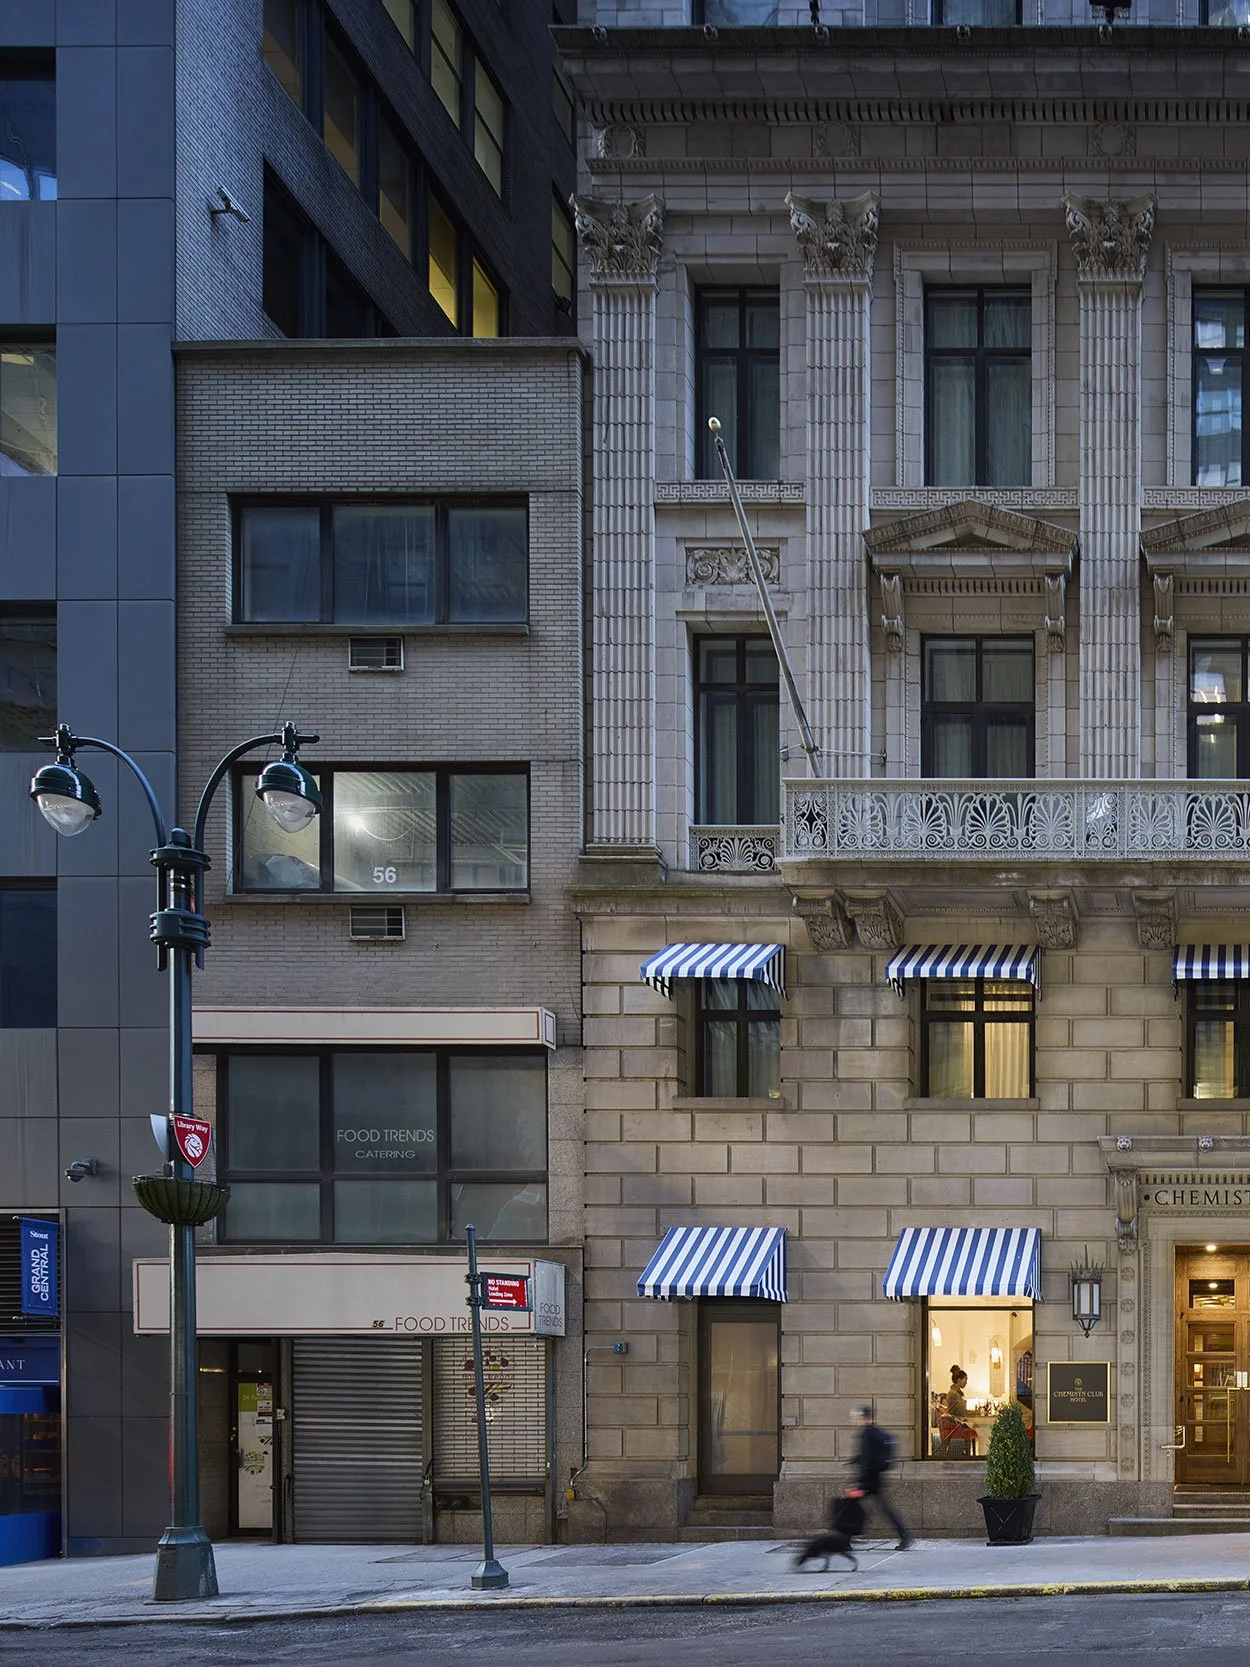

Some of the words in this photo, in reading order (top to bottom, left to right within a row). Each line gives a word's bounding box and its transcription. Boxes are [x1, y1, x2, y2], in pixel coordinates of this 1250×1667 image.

[372, 866, 397, 884] 56
[176, 1120, 195, 1132] Library
[195, 1123, 209, 1134] Way
[336, 1129, 380, 1142] FOOD
[383, 1129, 435, 1142] TRENDS
[355, 1150, 416, 1159] CATERING
[30, 1249, 40, 1294] GRAND
[39, 1243, 49, 1302] CENTRAL
[495, 1279, 520, 1288] STANDING
[540, 1303, 560, 1315] FOOD
[372, 1320, 385, 1328] 56
[395, 1316, 446, 1331] FOOD
[449, 1316, 509, 1331] TRENDS
[539, 1315, 563, 1327] TRENDS
